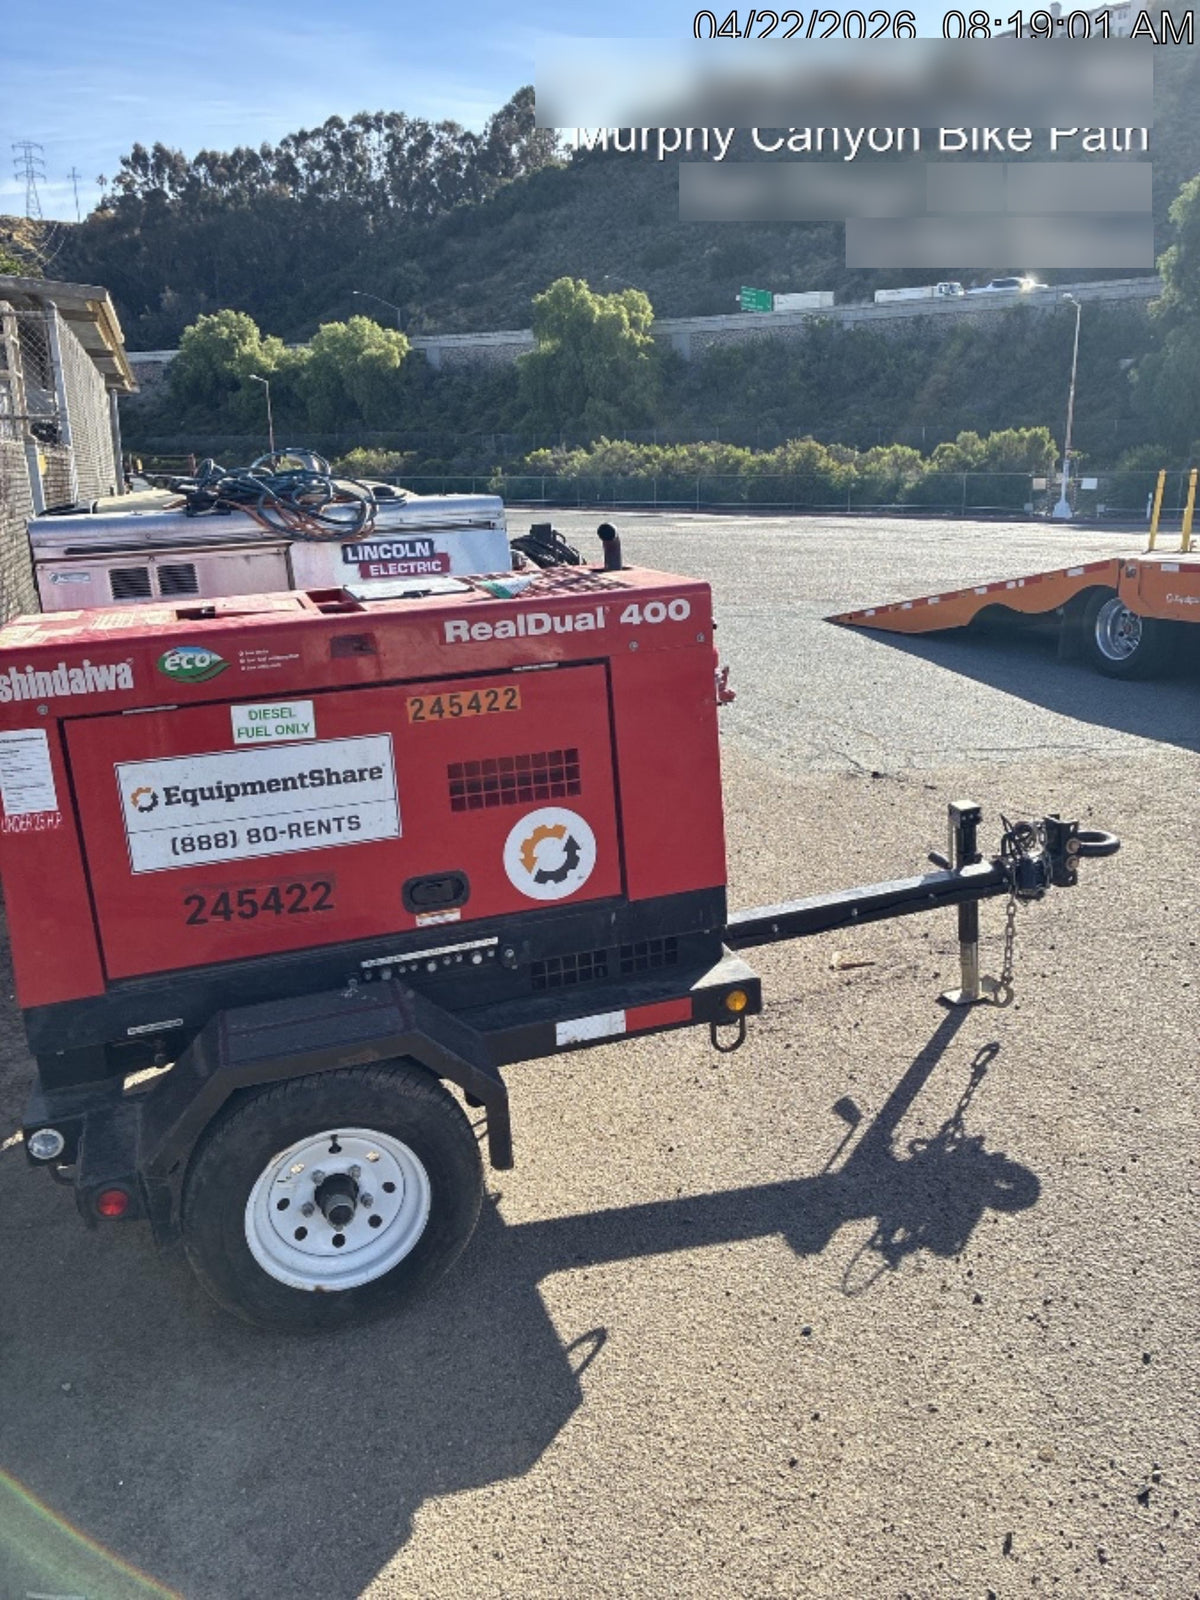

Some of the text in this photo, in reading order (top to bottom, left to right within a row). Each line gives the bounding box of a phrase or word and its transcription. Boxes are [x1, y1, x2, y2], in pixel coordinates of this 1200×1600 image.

[346, 541, 431, 561] LINCOLN
[369, 560, 443, 576] ELECTRIC
[443, 598, 691, 643] RealDual 400
[164, 652, 211, 671] eco
[0, 658, 134, 702] shindaiwa
[248, 706, 296, 721] DIESEL
[409, 687, 519, 721] 245422
[237, 722, 310, 738] FUEL ONLY
[163, 765, 384, 806] EquipmentShare
[171, 814, 362, 856] (888) 80-RENTS
[183, 880, 334, 926] 245422
